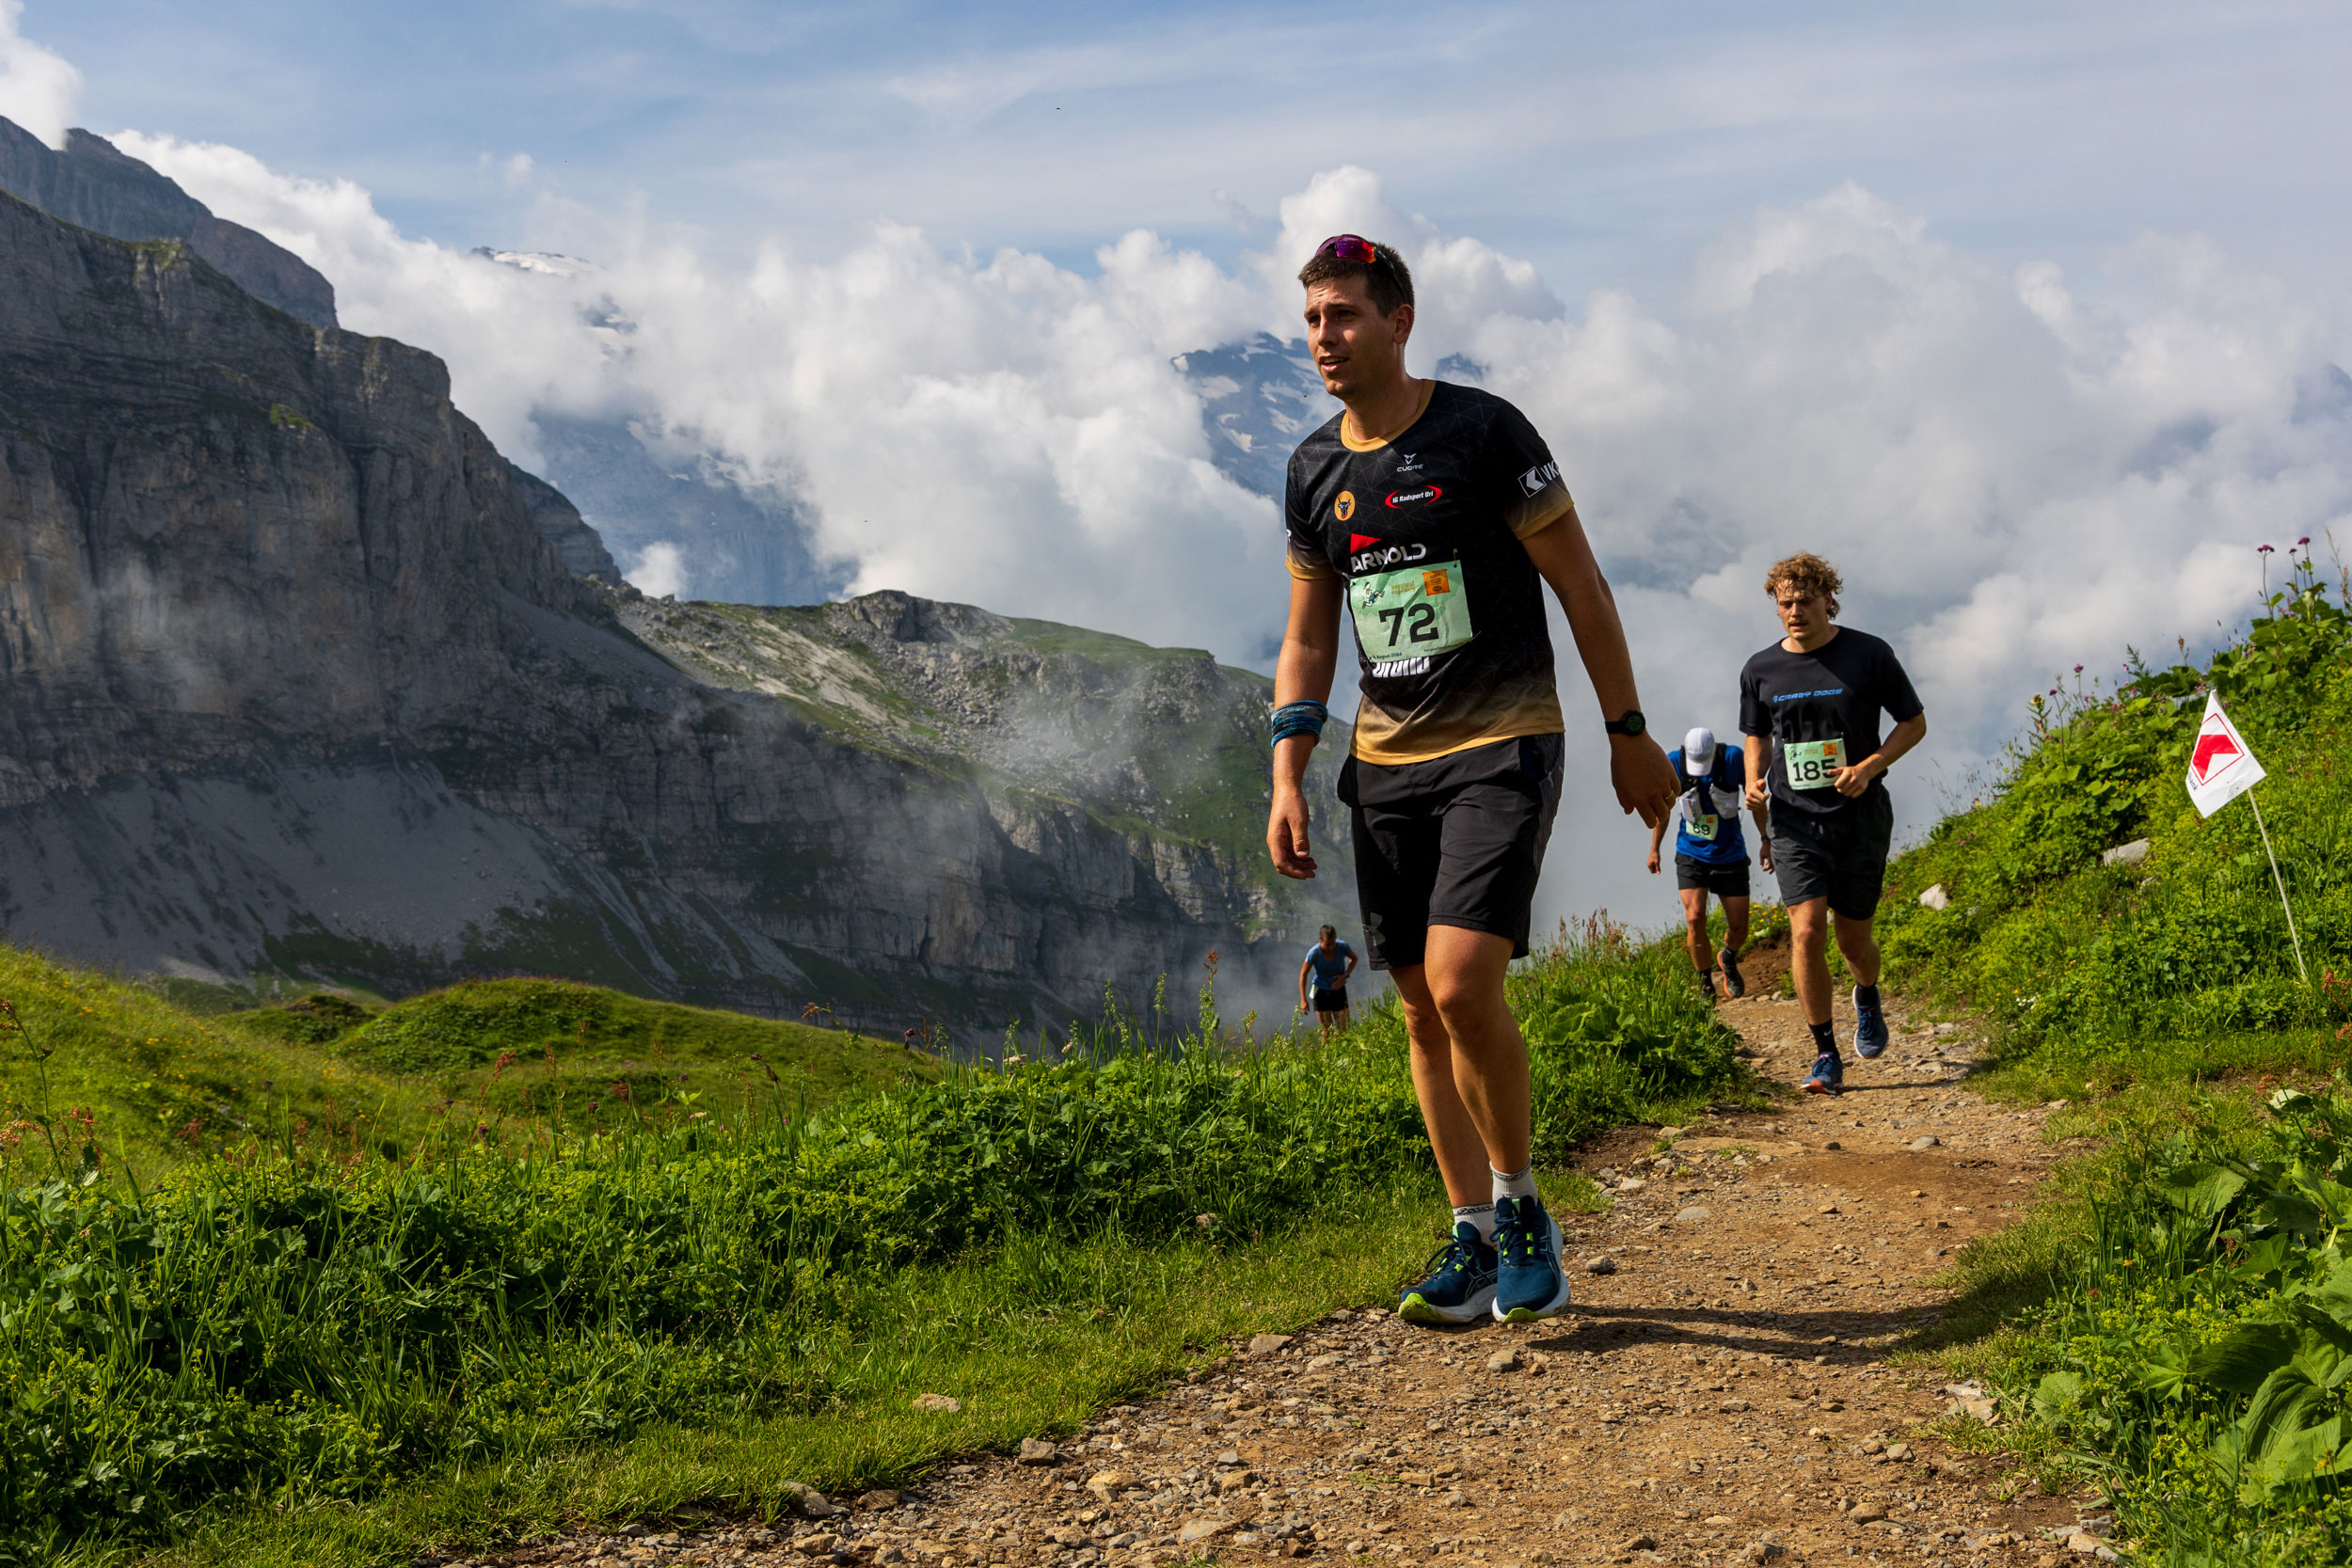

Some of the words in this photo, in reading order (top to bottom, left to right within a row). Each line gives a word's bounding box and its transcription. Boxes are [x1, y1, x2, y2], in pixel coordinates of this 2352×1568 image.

[1396, 464, 1424, 472] CUORE
[1399, 492, 1423, 502] Radsport
[1350, 543, 1427, 573] ARNOLD
[1378, 602, 1439, 647] 72
[1778, 691, 1811, 702] CRAZY
[1813, 689, 1843, 697] DOGS
[1792, 758, 1838, 782] 185
[1693, 822, 1710, 835] 69
